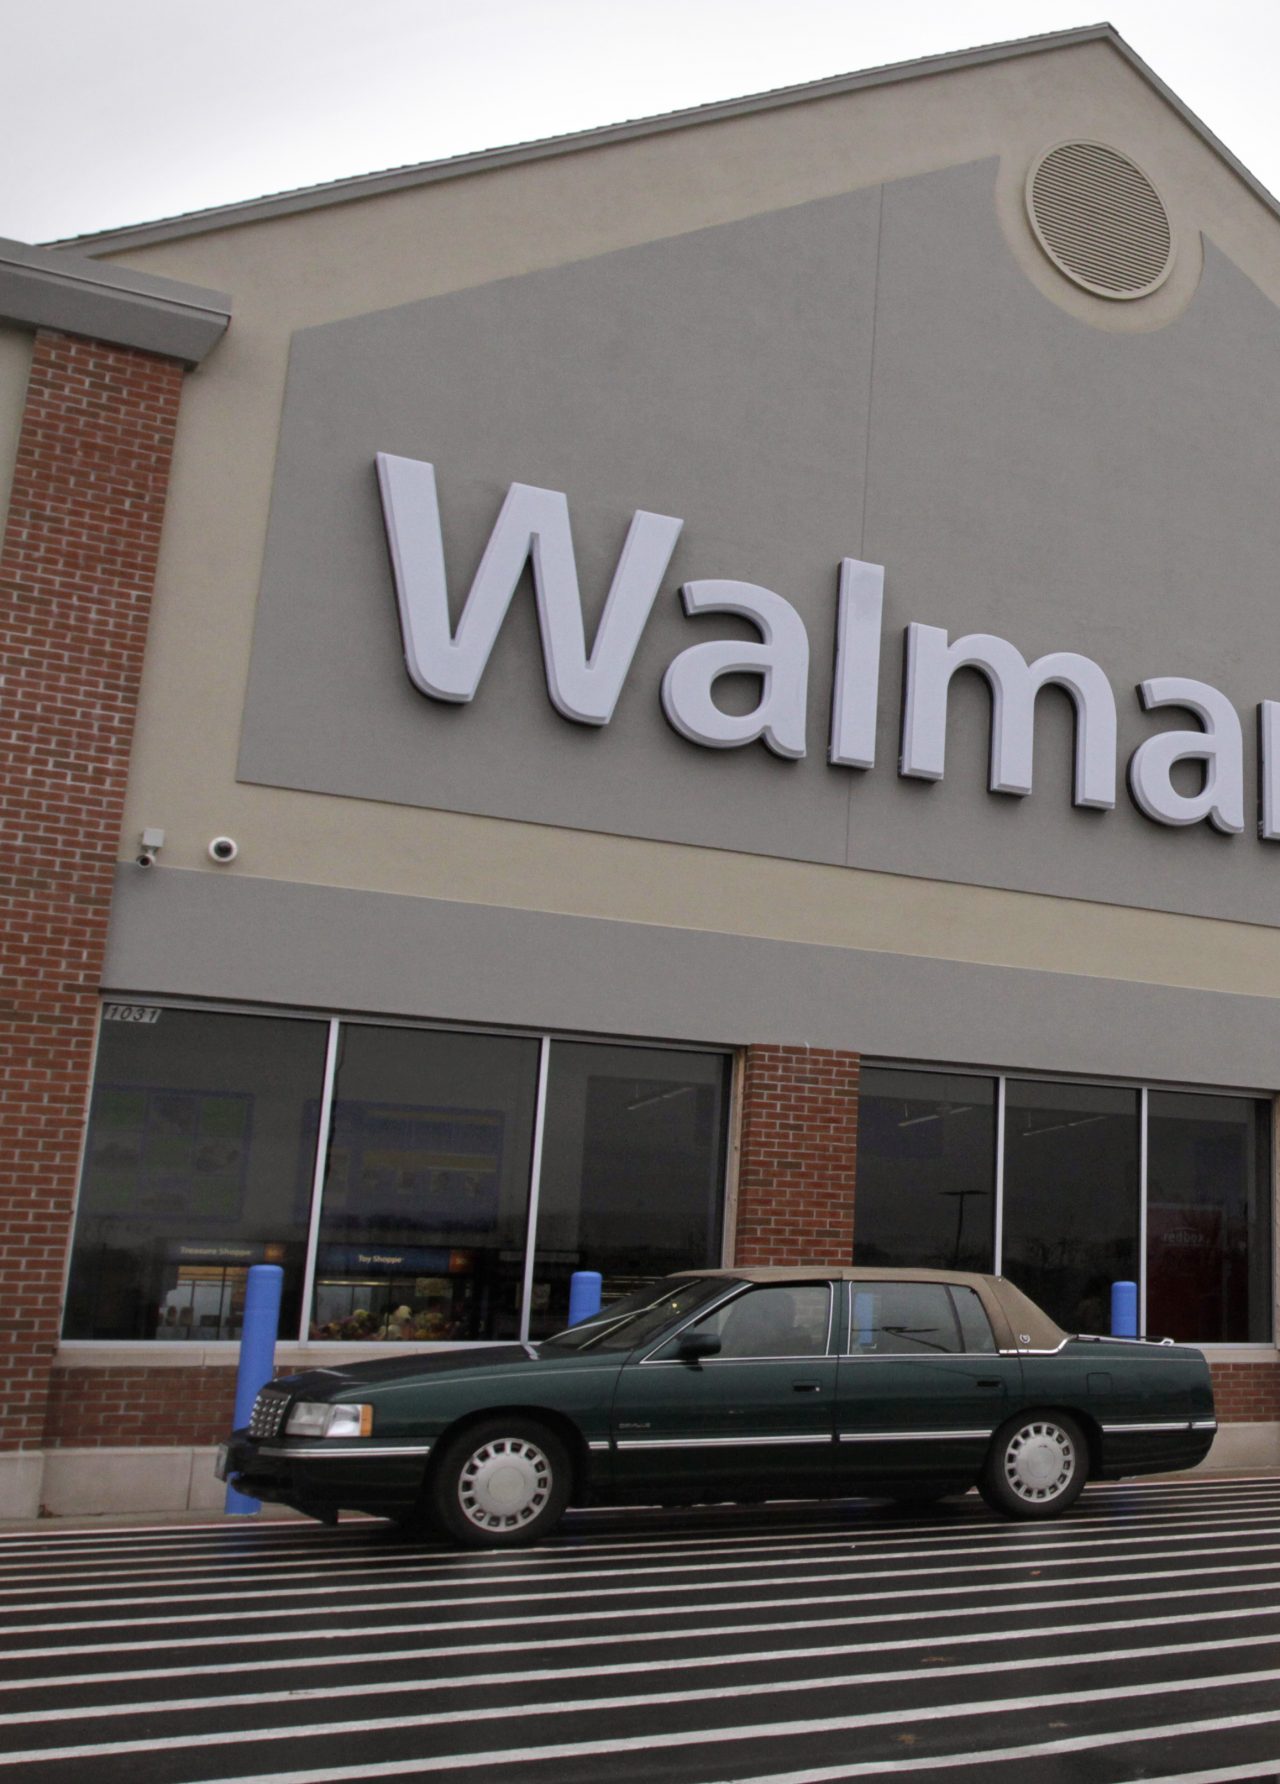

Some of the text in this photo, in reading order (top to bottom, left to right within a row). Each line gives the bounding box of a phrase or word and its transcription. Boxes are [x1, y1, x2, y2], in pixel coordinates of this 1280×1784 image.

[110, 1006, 157, 1021] 1031
[1162, 1231, 1205, 1244] redbox
[180, 1246, 217, 1255] Treasure
[358, 1254, 403, 1265] Toy Shoppe
